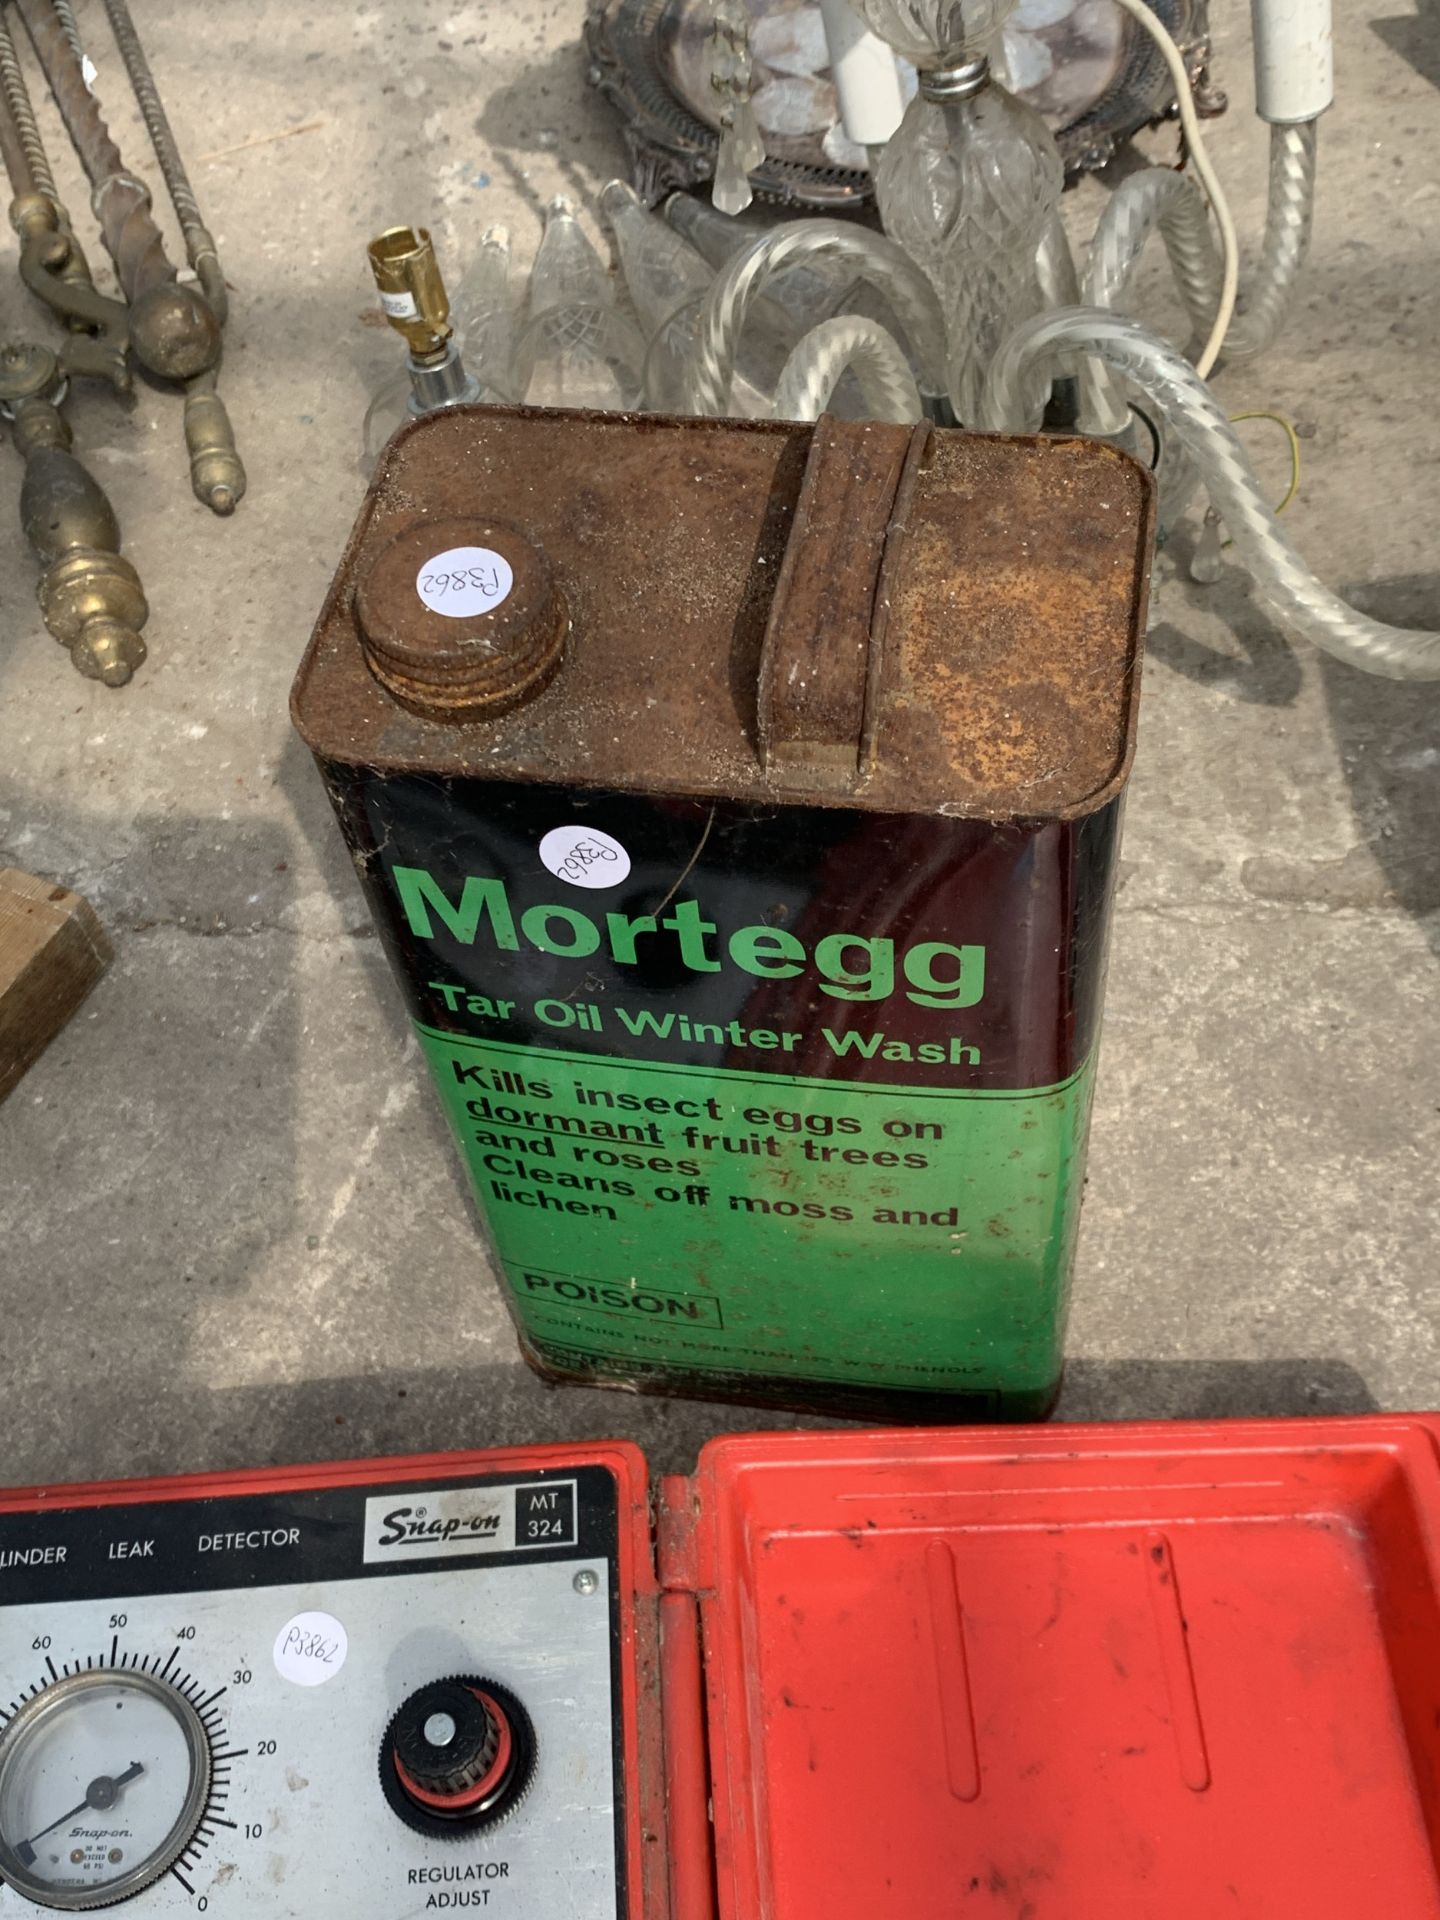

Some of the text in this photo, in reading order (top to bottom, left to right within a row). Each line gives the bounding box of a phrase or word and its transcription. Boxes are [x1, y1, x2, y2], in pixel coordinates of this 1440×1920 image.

[423, 568, 499, 597] P3862
[557, 837, 618, 879] P3862
[391, 865, 986, 1009] Mortegg
[428, 982, 981, 1065] Tar Oil Winter Wash
[452, 1060, 943, 1140] Kills insect eggs on
[466, 1097, 929, 1169] dormant fruit trees
[475, 1130, 702, 1177] and roses
[483, 1154, 959, 1227] Cleans off moss and
[490, 1180, 617, 1220] lichen
[523, 1273, 701, 1319] POISON
[530, 1493, 559, 1511] MT
[378, 1508, 501, 1545] Snap-on
[528, 1520, 563, 1537] 324
[109, 1540, 155, 1559] LEAK
[198, 1528, 300, 1551] DETECTOR
[109, 1615, 127, 1628] 50
[177, 1626, 196, 1641] 40
[31, 1636, 52, 1650] 60
[233, 1671, 252, 1685] 30
[257, 1741, 277, 1756] 20
[245, 1823, 263, 1839] 10
[408, 1862, 509, 1885] REGULATOR
[197, 1896, 208, 1912] 0
[425, 1889, 491, 1909] ADJUST
